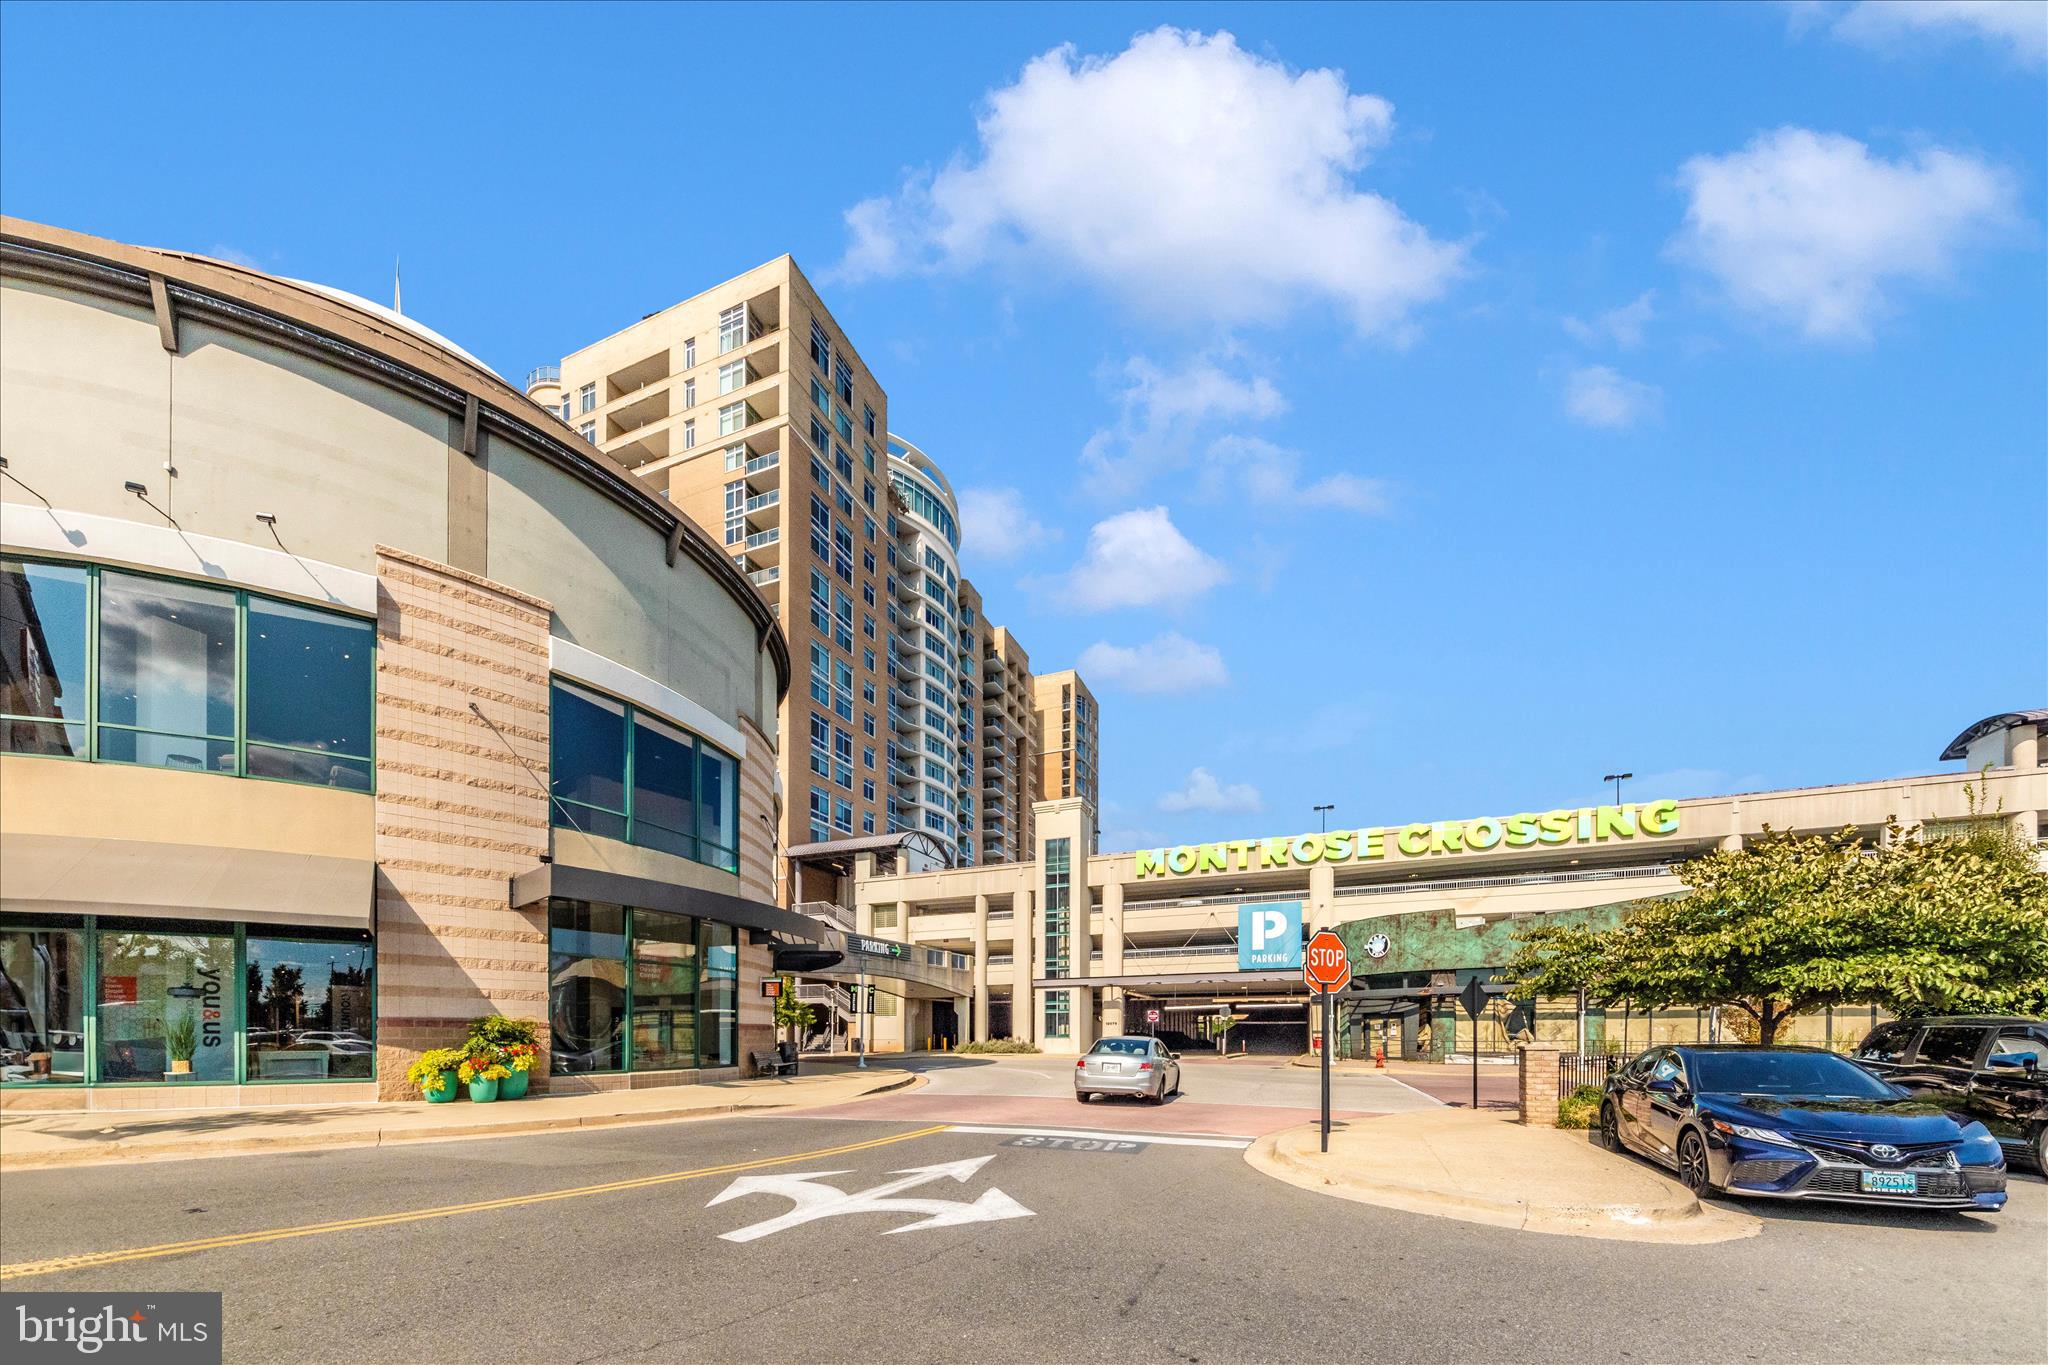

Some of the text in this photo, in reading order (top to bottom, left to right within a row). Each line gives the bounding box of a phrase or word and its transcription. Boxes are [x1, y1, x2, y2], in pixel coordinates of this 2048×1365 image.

[1136, 799, 1681, 877] MONTROSE CROSSING
[1252, 911, 1288, 951] P
[861, 939, 890, 955] PARKING
[1252, 953, 1288, 964] PARKING
[1311, 948, 1344, 968] STOP
[1012, 1136, 1137, 1151] STOP
[1872, 1176, 1905, 1188] 89251
